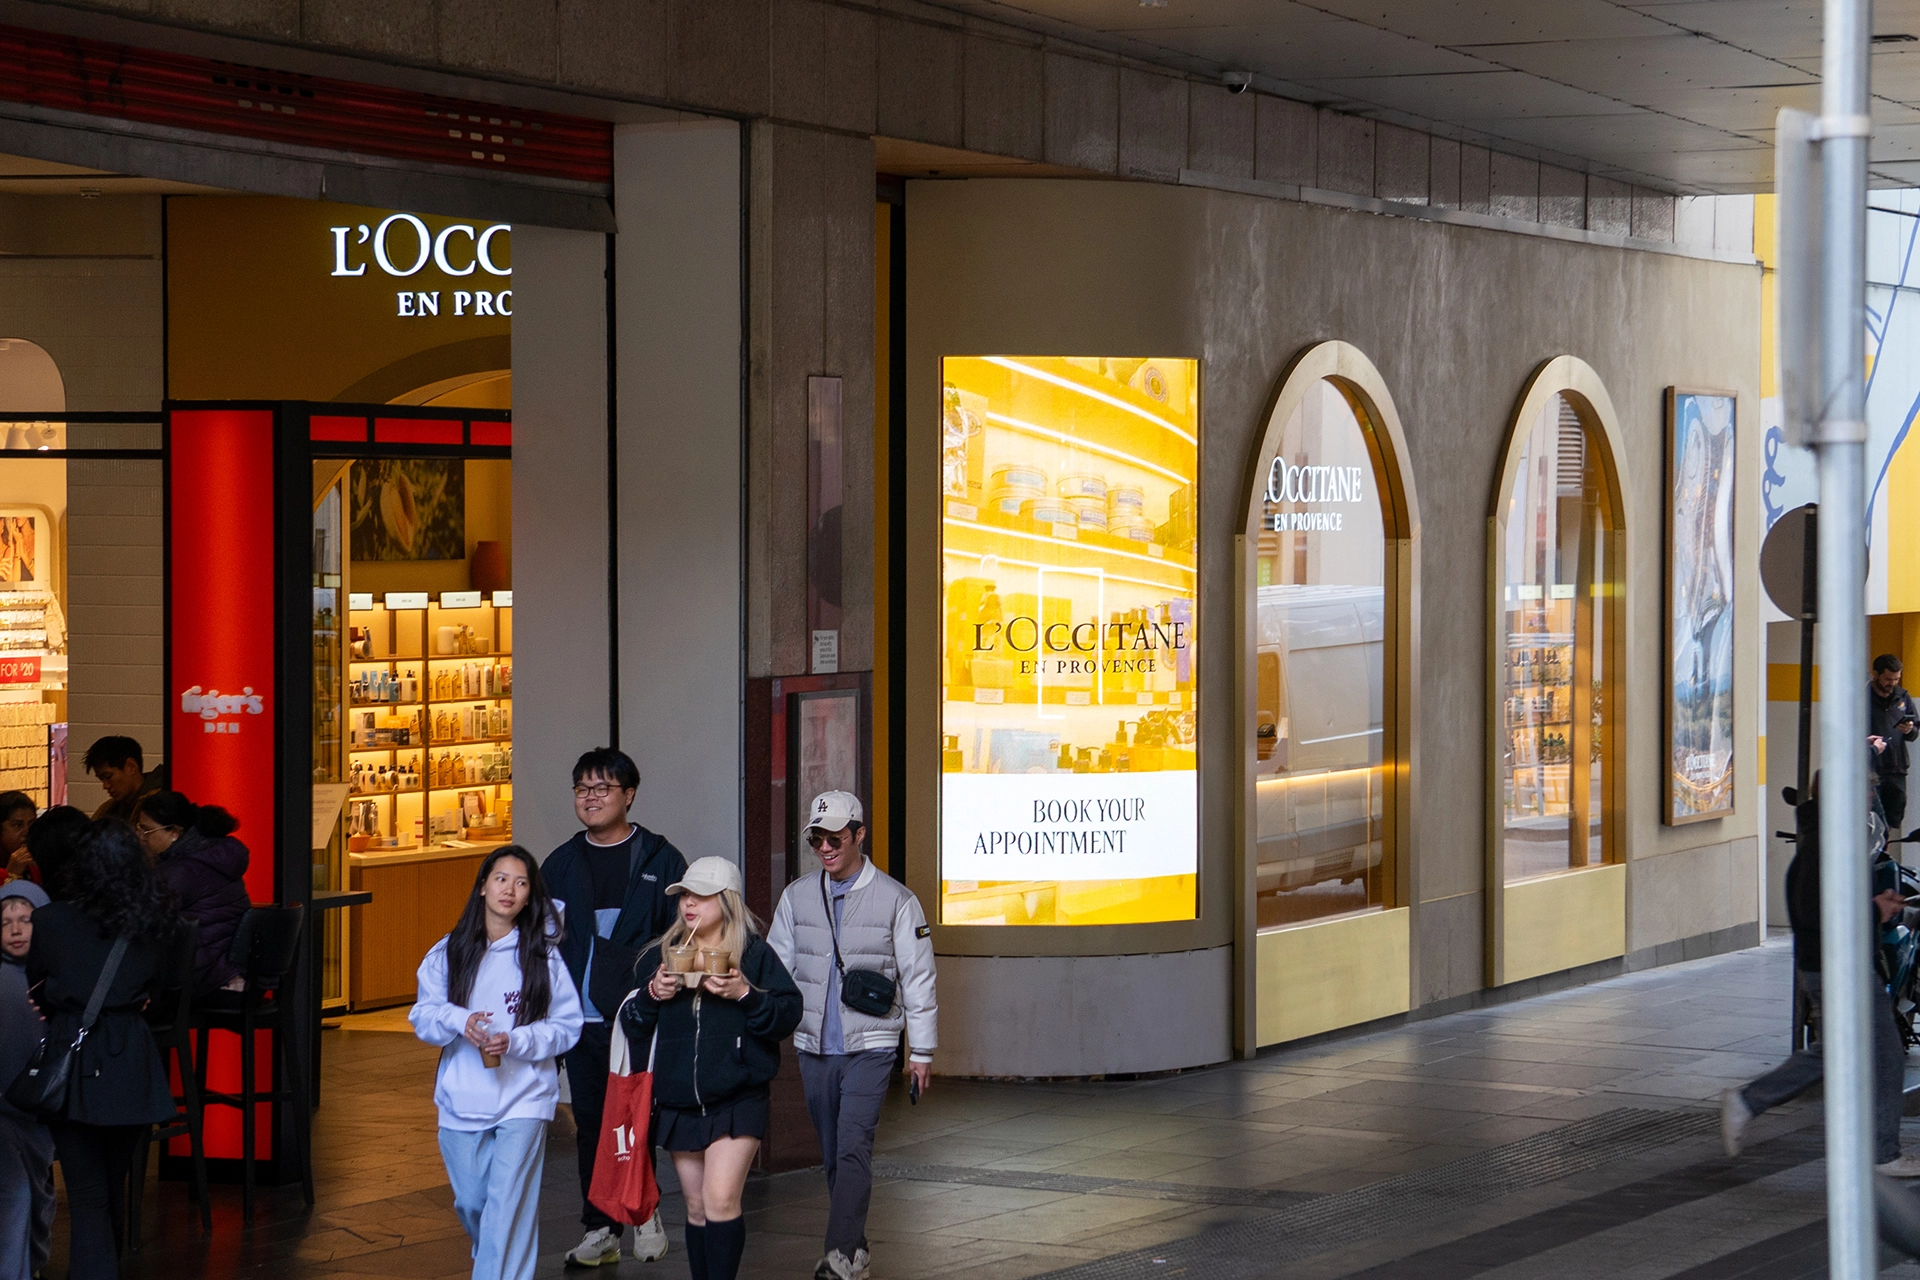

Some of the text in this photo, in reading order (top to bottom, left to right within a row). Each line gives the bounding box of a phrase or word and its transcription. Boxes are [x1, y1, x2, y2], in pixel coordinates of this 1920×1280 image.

[397, 291, 440, 316] EN
[1274, 512, 1342, 532] EN PROVENCE
[973, 617, 1186, 652] L'OCCITANE
[0, 662, 19, 677] FOR
[1020, 658, 1157, 674] EN PROVENCE
[204, 722, 240, 734] DEN
[817, 798, 828, 812] LA
[1033, 797, 1146, 823] BOOK YOUR
[973, 830, 1127, 855] APPOINTMENT
